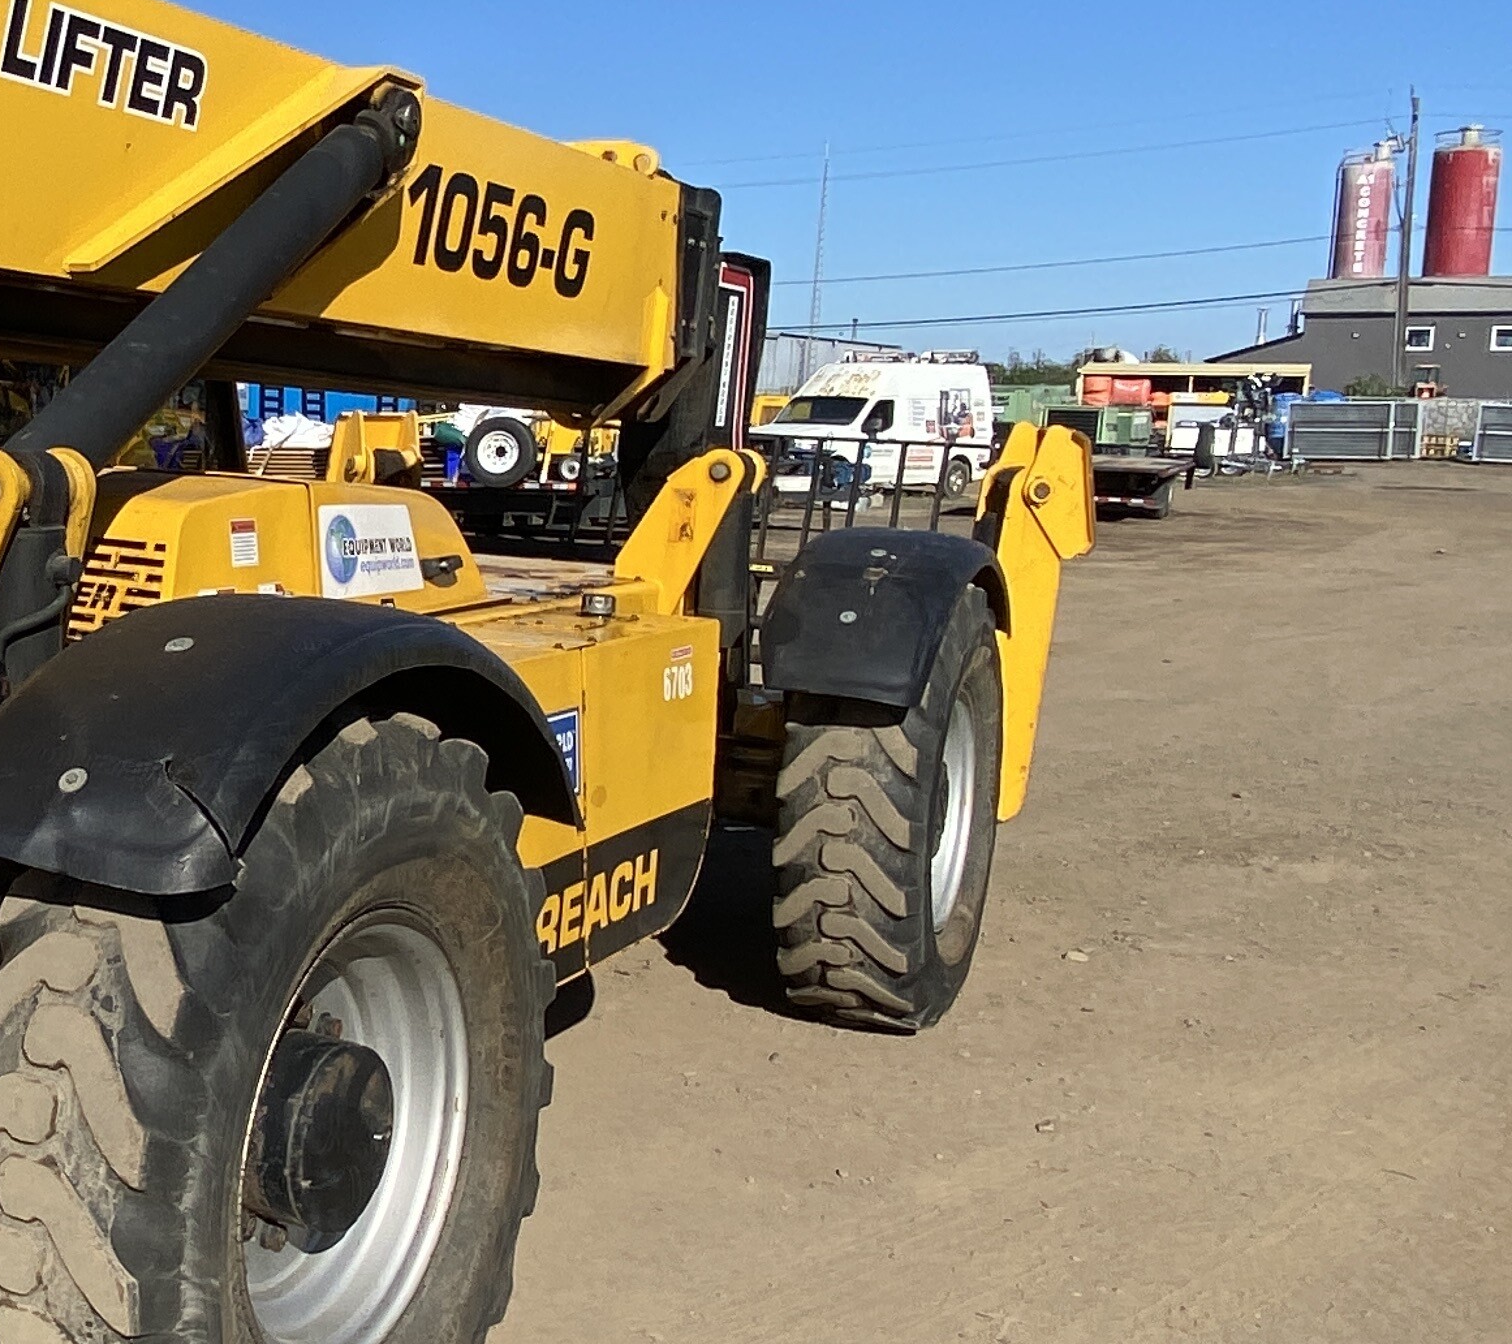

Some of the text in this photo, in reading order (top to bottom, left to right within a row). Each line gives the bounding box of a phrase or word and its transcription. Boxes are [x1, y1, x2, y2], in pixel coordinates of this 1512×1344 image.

[407, 163, 595, 298] 1056-G
[663, 662, 693, 702] 6703
[536, 848, 659, 955] REACH
